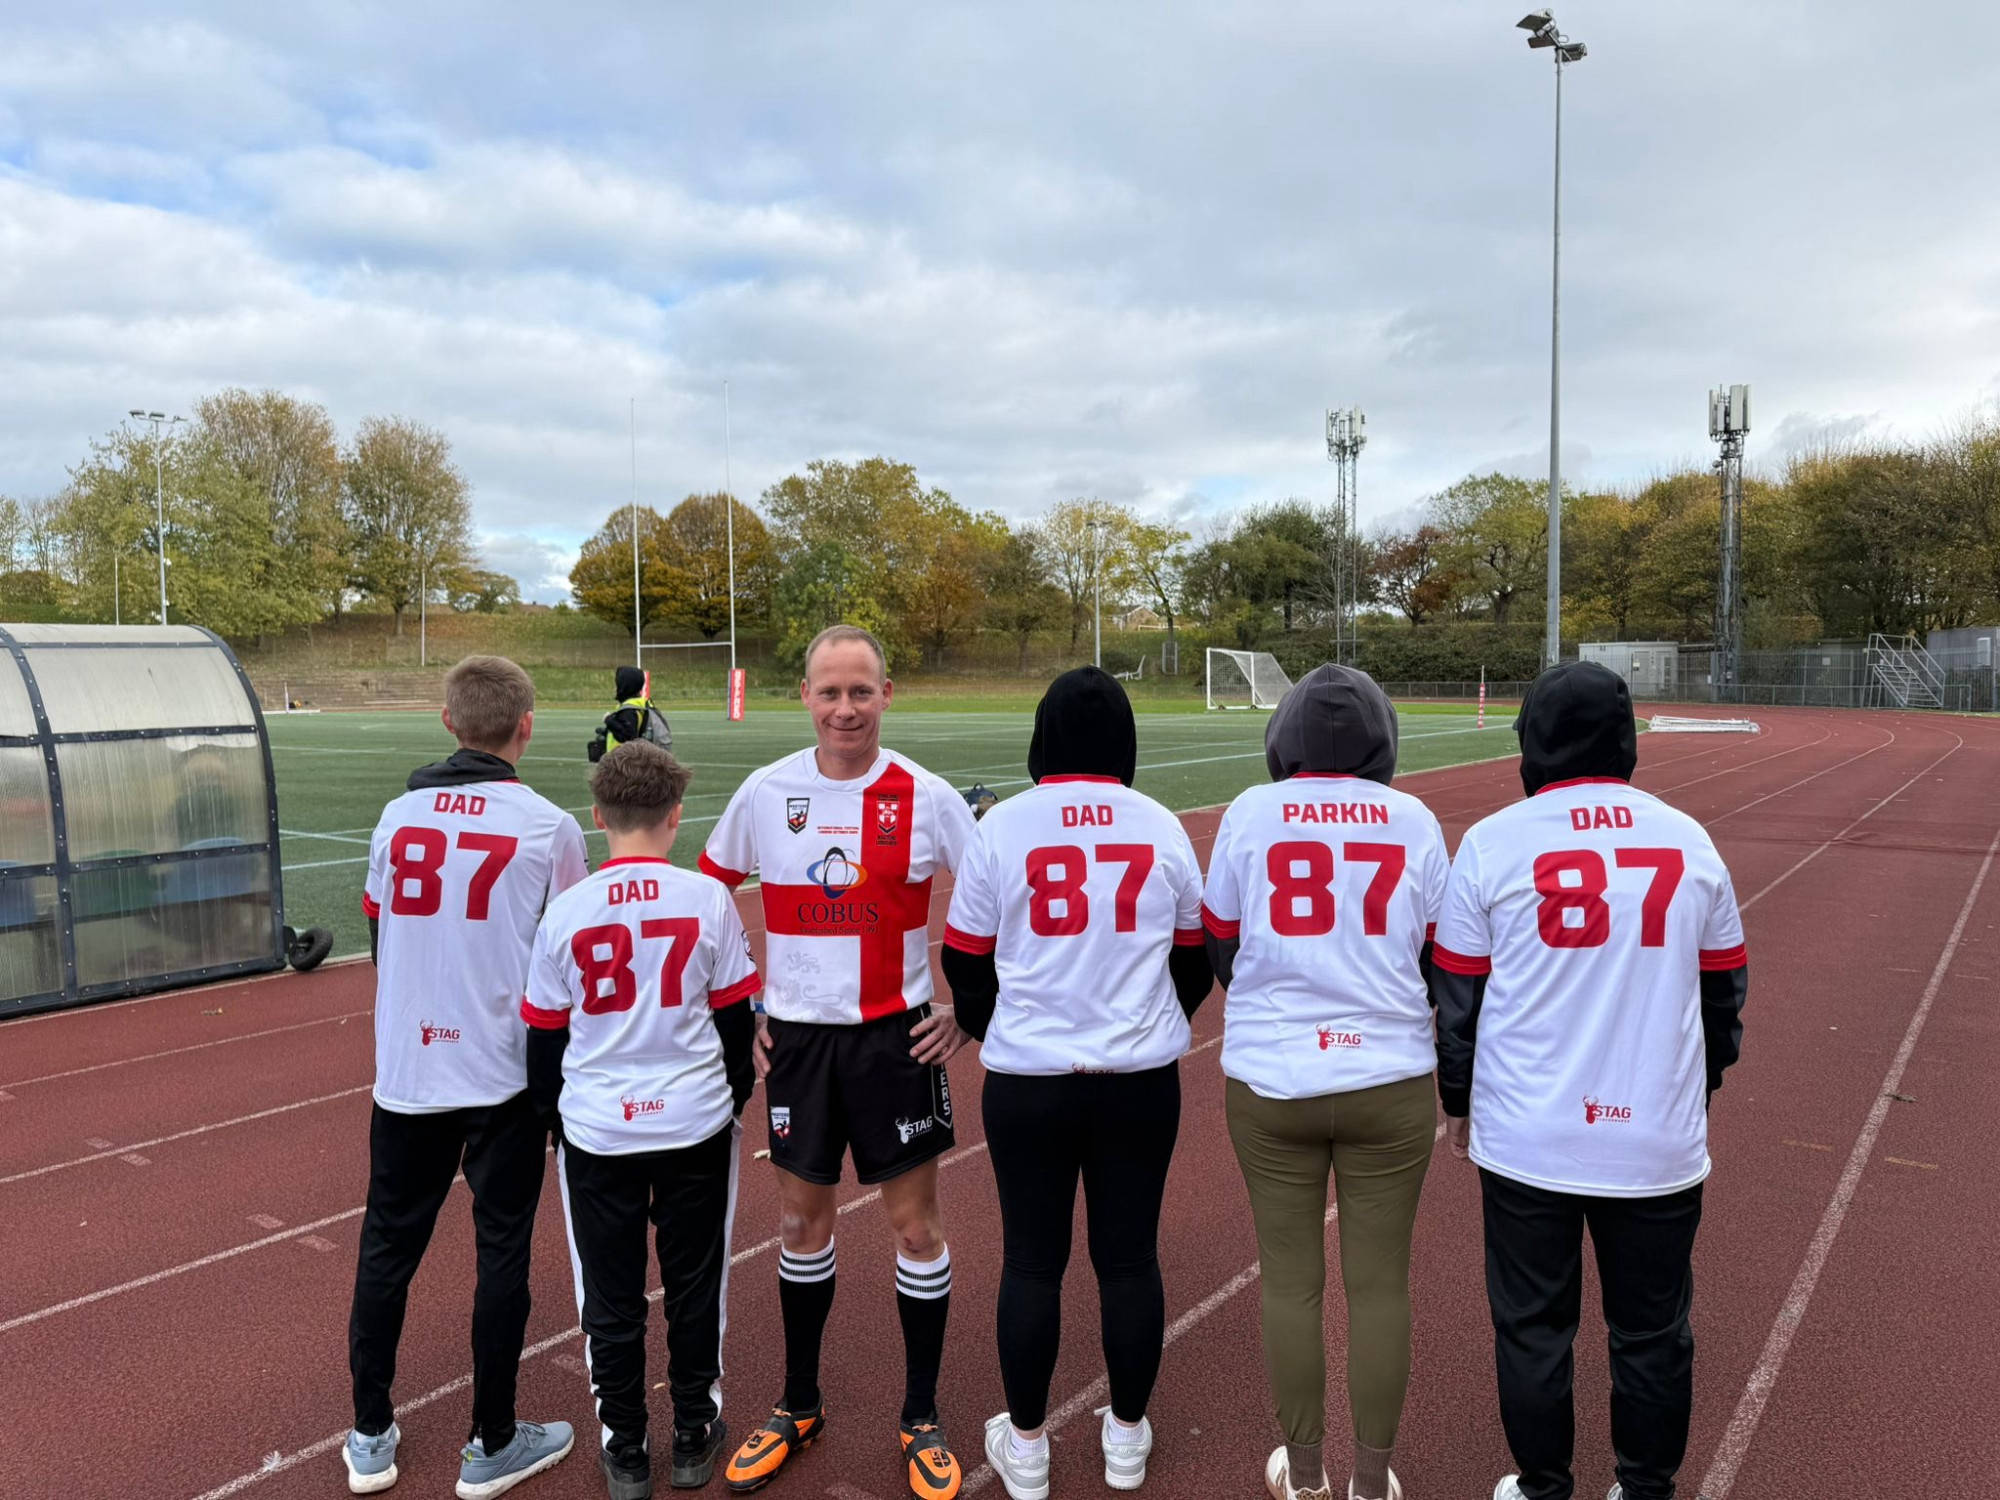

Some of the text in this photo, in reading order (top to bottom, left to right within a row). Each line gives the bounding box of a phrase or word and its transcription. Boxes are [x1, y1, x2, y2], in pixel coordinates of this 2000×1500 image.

[434, 793, 486, 815] DAD
[1283, 803, 1389, 825] PARKIN
[1062, 804, 1112, 828] DAD
[1571, 806, 1633, 830] DAD
[390, 826, 519, 920] 87
[608, 879, 659, 905] DAD
[1026, 843, 1155, 936] 87
[1267, 840, 1406, 936] 87
[1533, 847, 1685, 948] 87
[798, 903, 879, 924] COBUS
[571, 916, 700, 1015] 87
[429, 1028, 460, 1040] STAG
[1327, 1032, 1362, 1045] STAG
[630, 1099, 665, 1114] STAG
[1592, 1105, 1632, 1119] STAG
[905, 1115, 933, 1136] STAG
